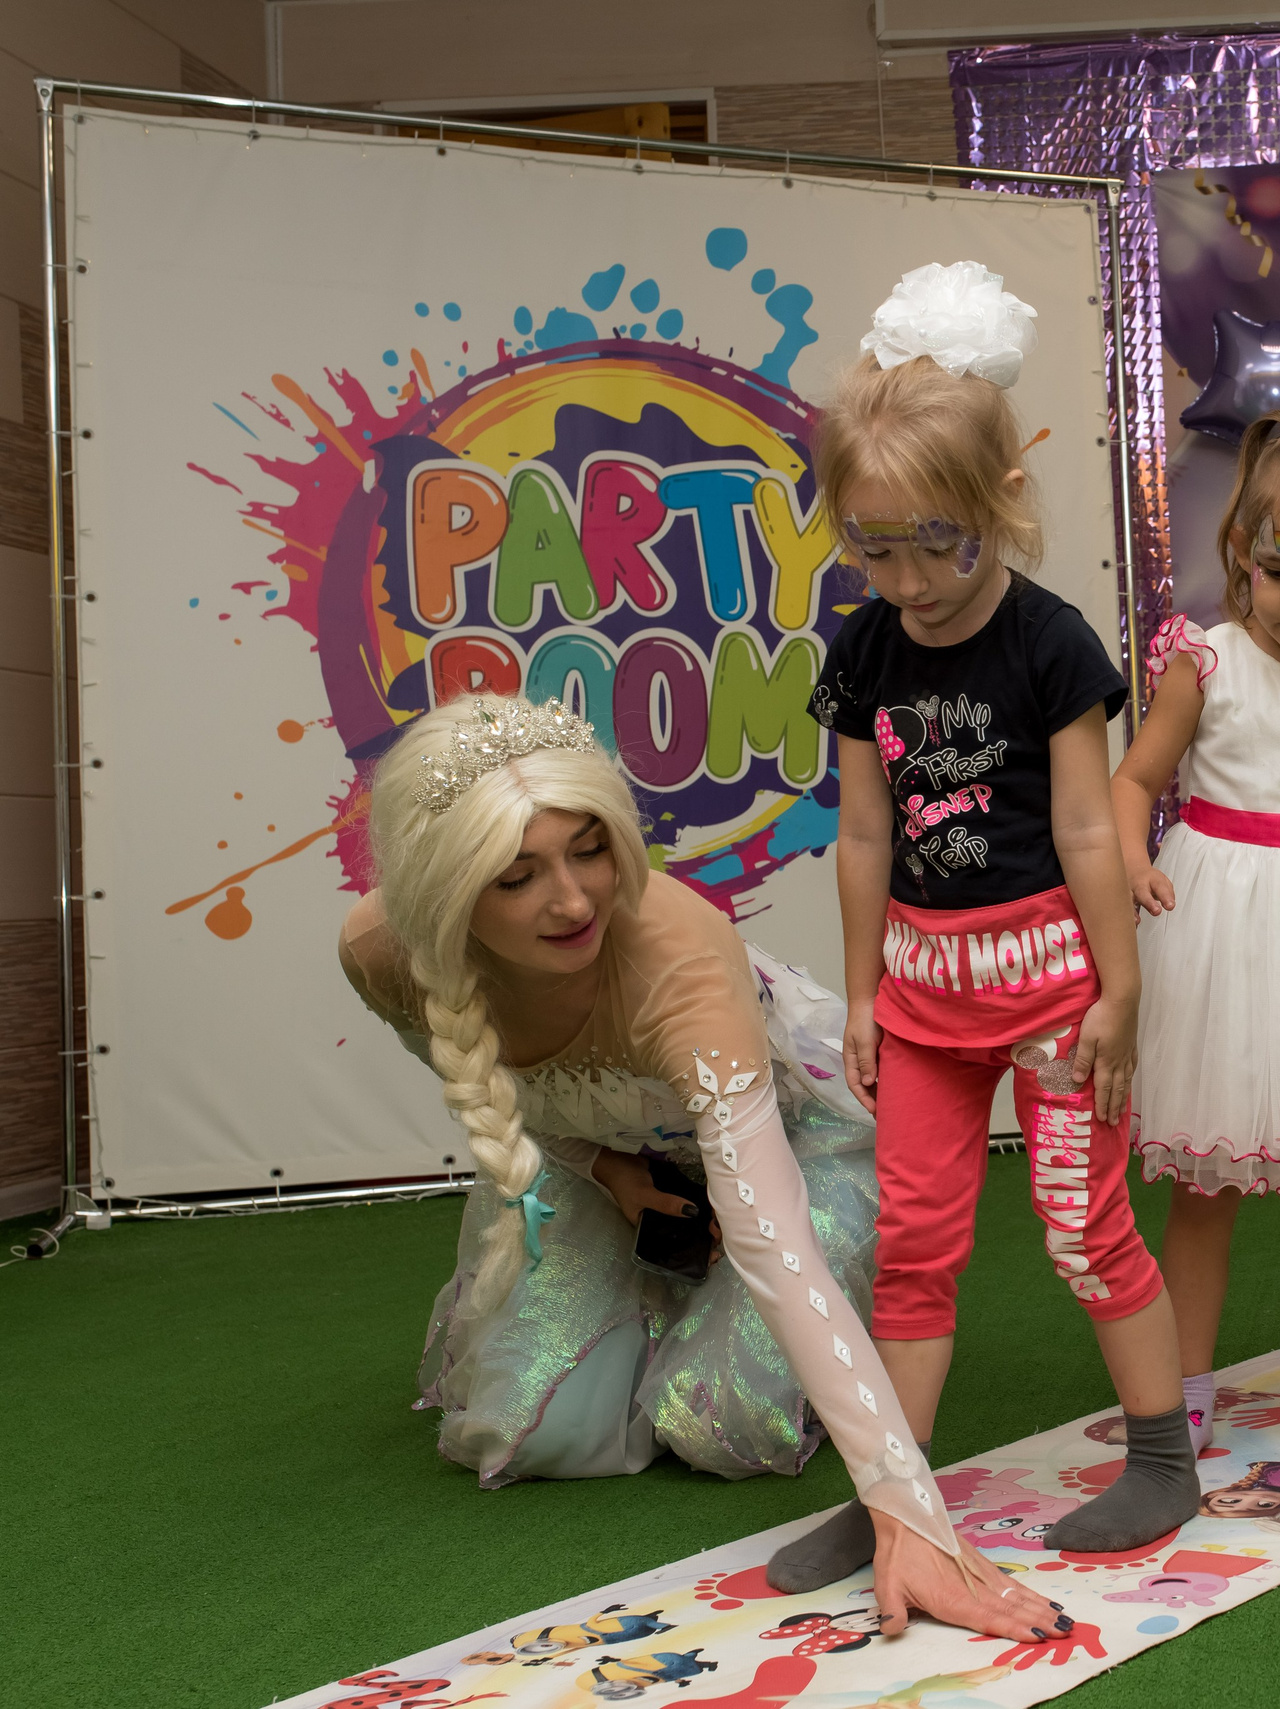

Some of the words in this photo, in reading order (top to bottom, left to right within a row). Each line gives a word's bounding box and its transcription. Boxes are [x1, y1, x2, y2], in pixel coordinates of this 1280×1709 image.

[407, 451, 842, 632] PARTY
[883, 917, 962, 997] MICKEY
[966, 918, 1089, 997] MOUSE
